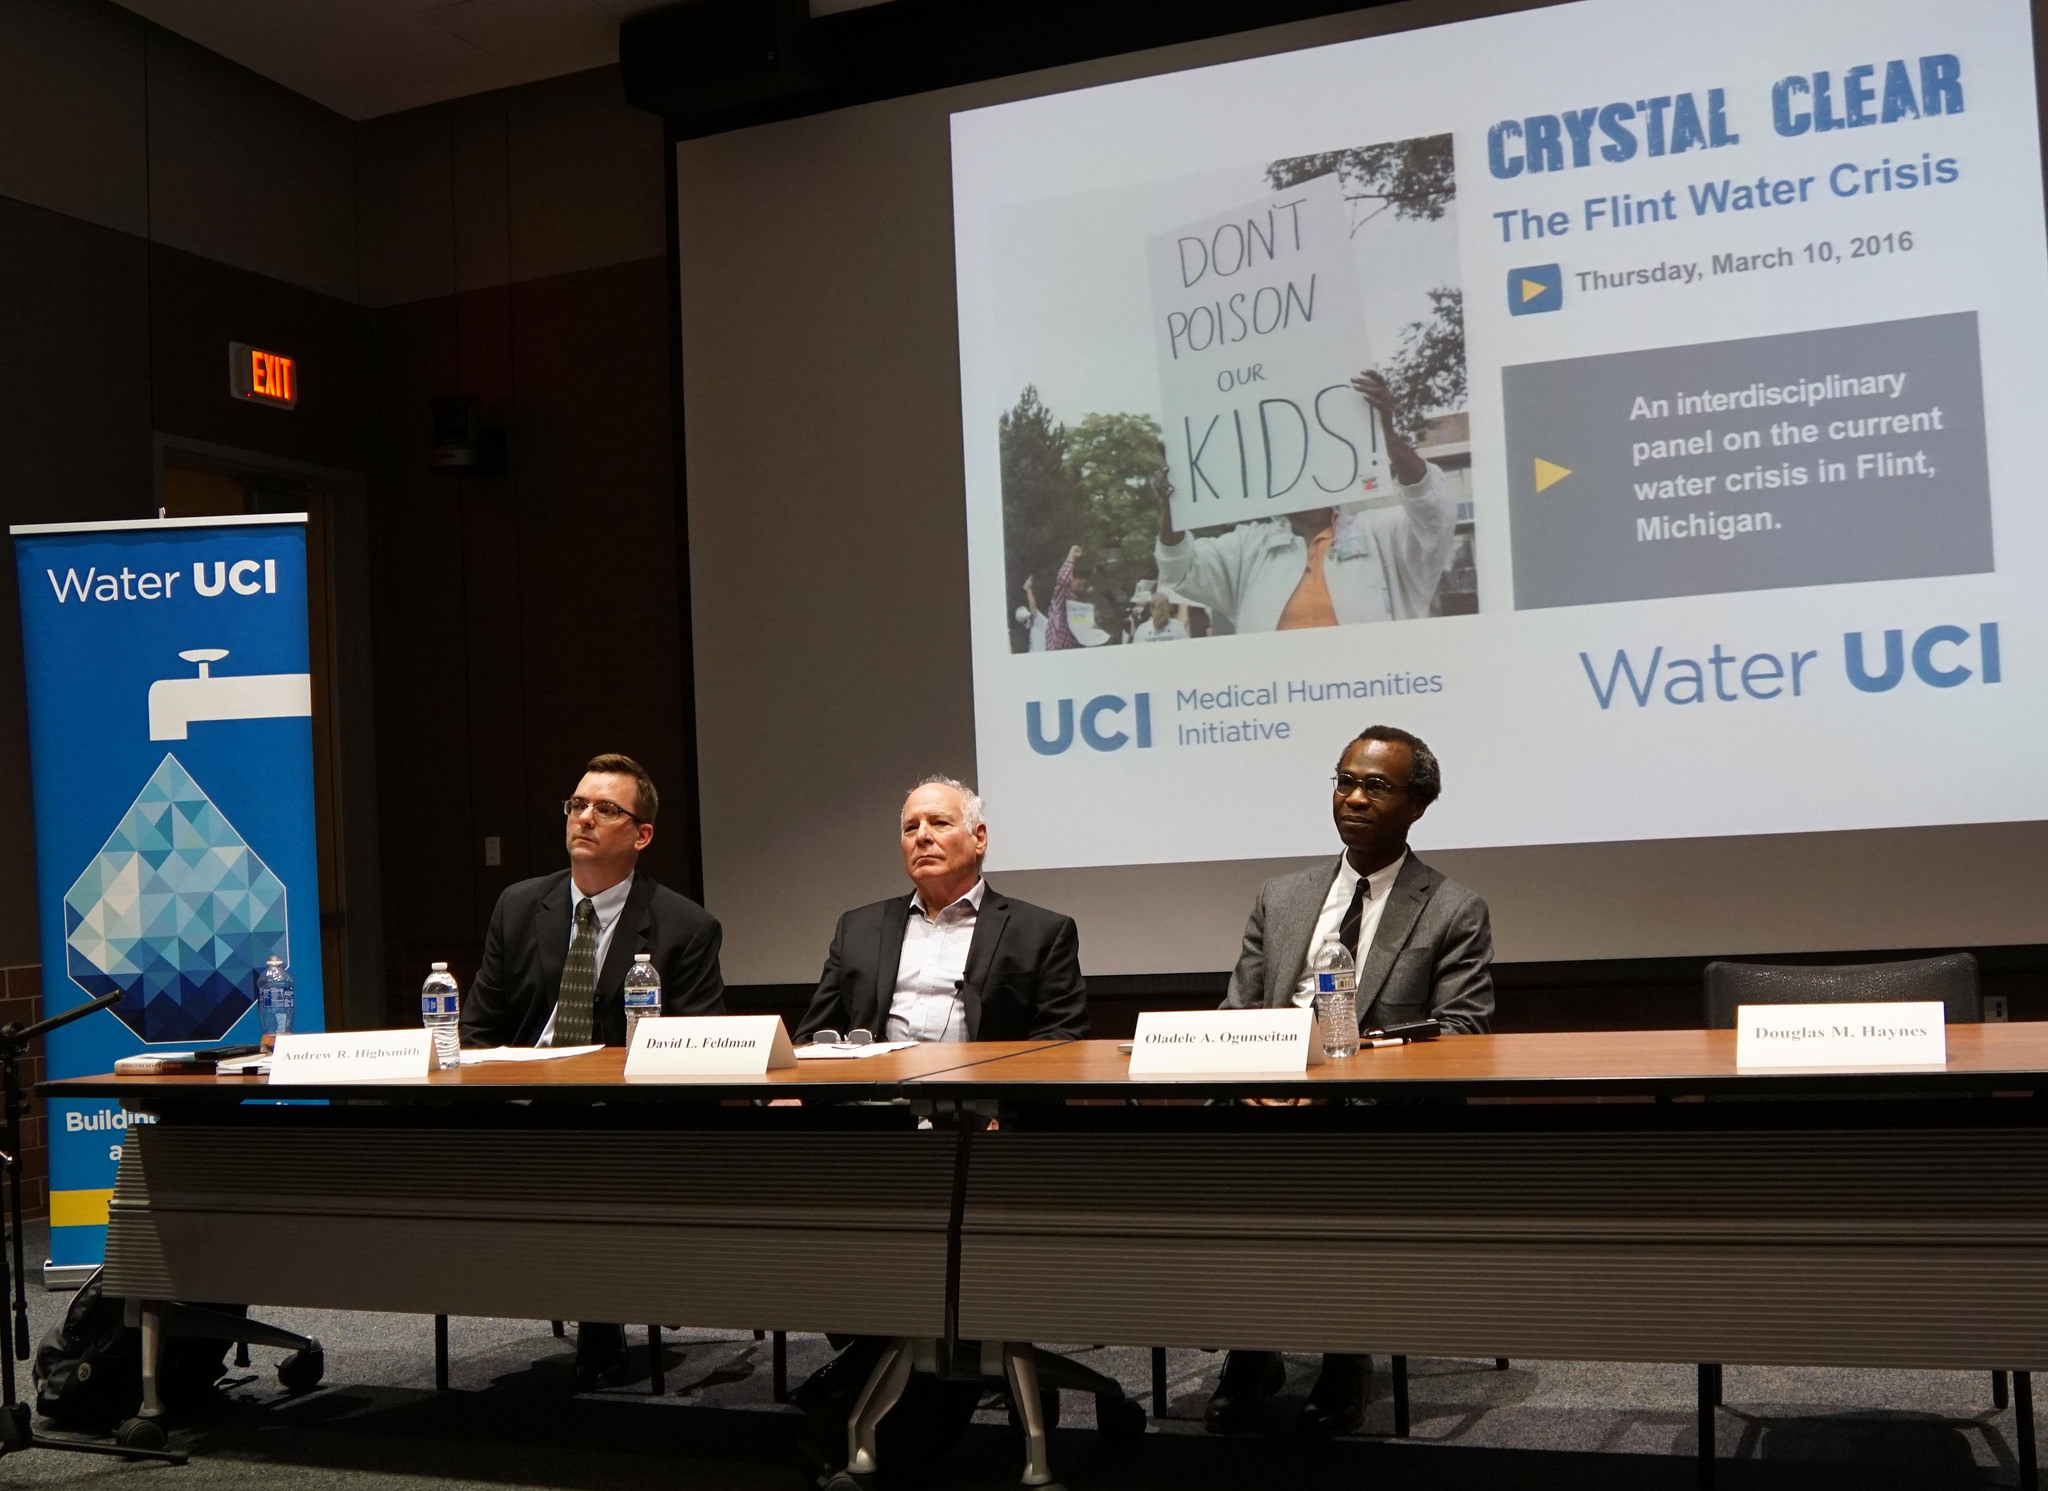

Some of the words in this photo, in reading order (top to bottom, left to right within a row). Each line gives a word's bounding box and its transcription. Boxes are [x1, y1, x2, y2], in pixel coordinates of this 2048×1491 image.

[1488, 87, 1739, 179] CRYSTAL
[1772, 54, 1964, 137] CLEAR
[1493, 209, 1569, 242] The
[1585, 190, 1677, 231] Flint
[1688, 177, 1815, 215] Water
[1829, 152, 1959, 198] Crisis
[1576, 260, 1704, 292] Thursday,
[1712, 247, 1793, 275] March
[1803, 242, 1842, 264] 10,
[1850, 230, 1914, 258] 2016
[1167, 273, 1316, 360] POISON
[251, 350, 292, 400] EXIT
[1217, 364, 1265, 392] OUR
[1630, 397, 1668, 420] An
[1677, 371, 1906, 416] interdisciplinary
[1185, 384, 1378, 503] KIDS!
[1633, 430, 1712, 466] panel
[1723, 431, 1760, 451] on
[1770, 422, 1819, 446] the
[1828, 407, 1943, 440] current
[1634, 475, 1716, 500] water
[1725, 463, 1808, 492] crisis
[1819, 459, 1846, 482] in
[1857, 451, 1935, 479] Flint,
[1637, 511, 1781, 541] Michigan.
[47, 567, 180, 603] Water
[194, 559, 276, 596] UCI
[1579, 644, 1817, 709] Water
[1844, 622, 2001, 693] UCI
[1177, 682, 1277, 711] Medical
[1288, 672, 1442, 703] Humanities
[1026, 693, 1152, 755] UCI
[1179, 719, 1290, 745] Initiative
[282, 1051, 332, 1061] Andrew
[337, 1050, 350, 1059] R.
[355, 1047, 421, 1059] Highsmith
[646, 1038, 683, 1049] David
[685, 1037, 698, 1049] L.
[702, 1037, 756, 1049] Feldman
[1145, 1033, 1196, 1044] Oladele
[1200, 1033, 1215, 1043] A.
[1219, 1031, 1298, 1045] Ogunseitan
[1755, 1027, 1825, 1041] Douglas
[1831, 1026, 1855, 1038] M.
[1862, 1025, 1928, 1040] Haynes
